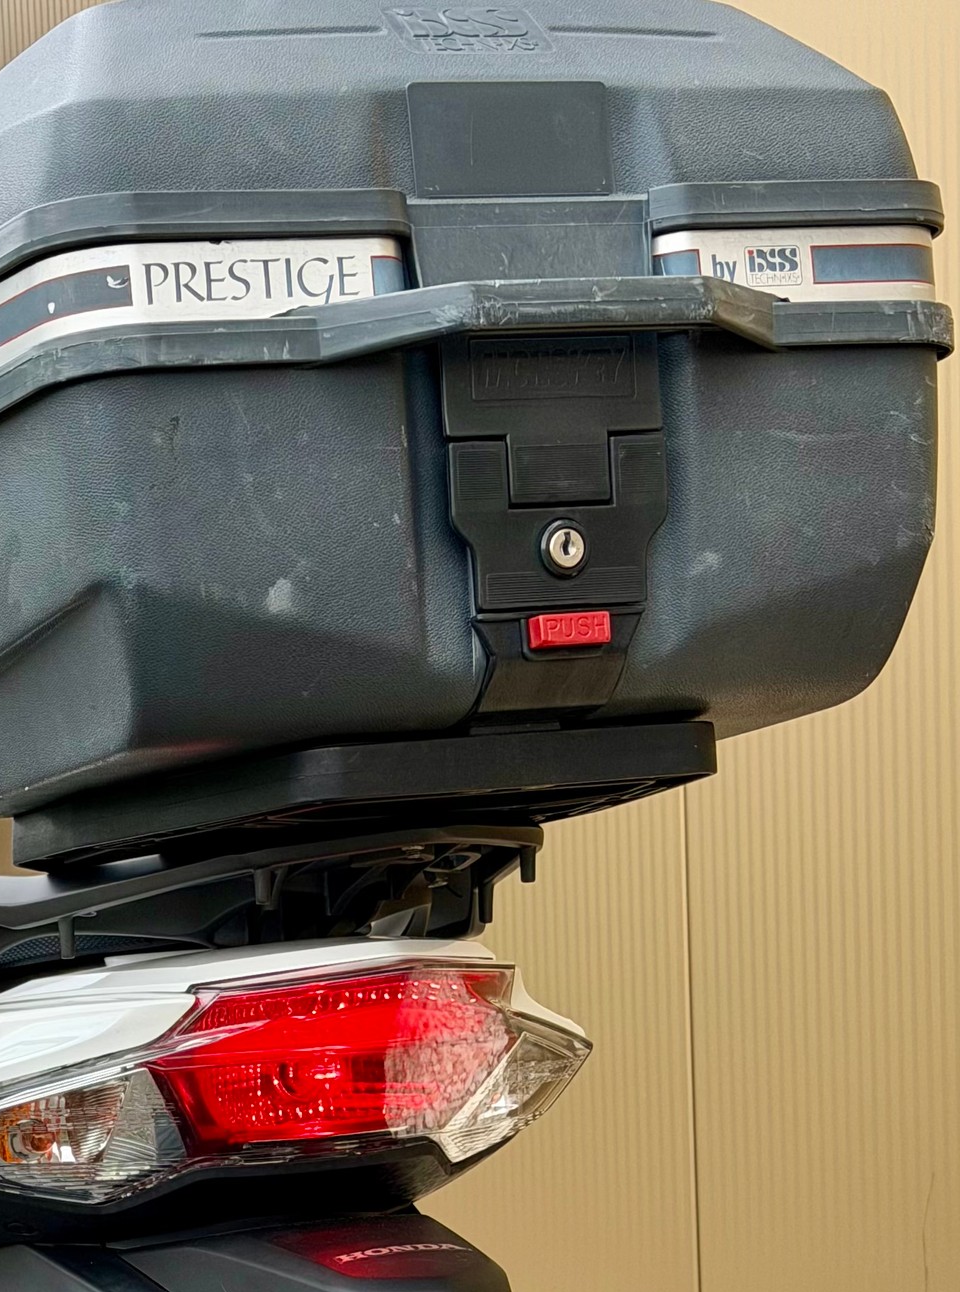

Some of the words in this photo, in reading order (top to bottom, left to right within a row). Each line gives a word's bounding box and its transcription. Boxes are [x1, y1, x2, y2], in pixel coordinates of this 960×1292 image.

[142, 255, 361, 305] PRESTIGE
[711, 253, 738, 283] by
[545, 616, 608, 641] PUSH
[334, 1242, 468, 1265] HONDA
